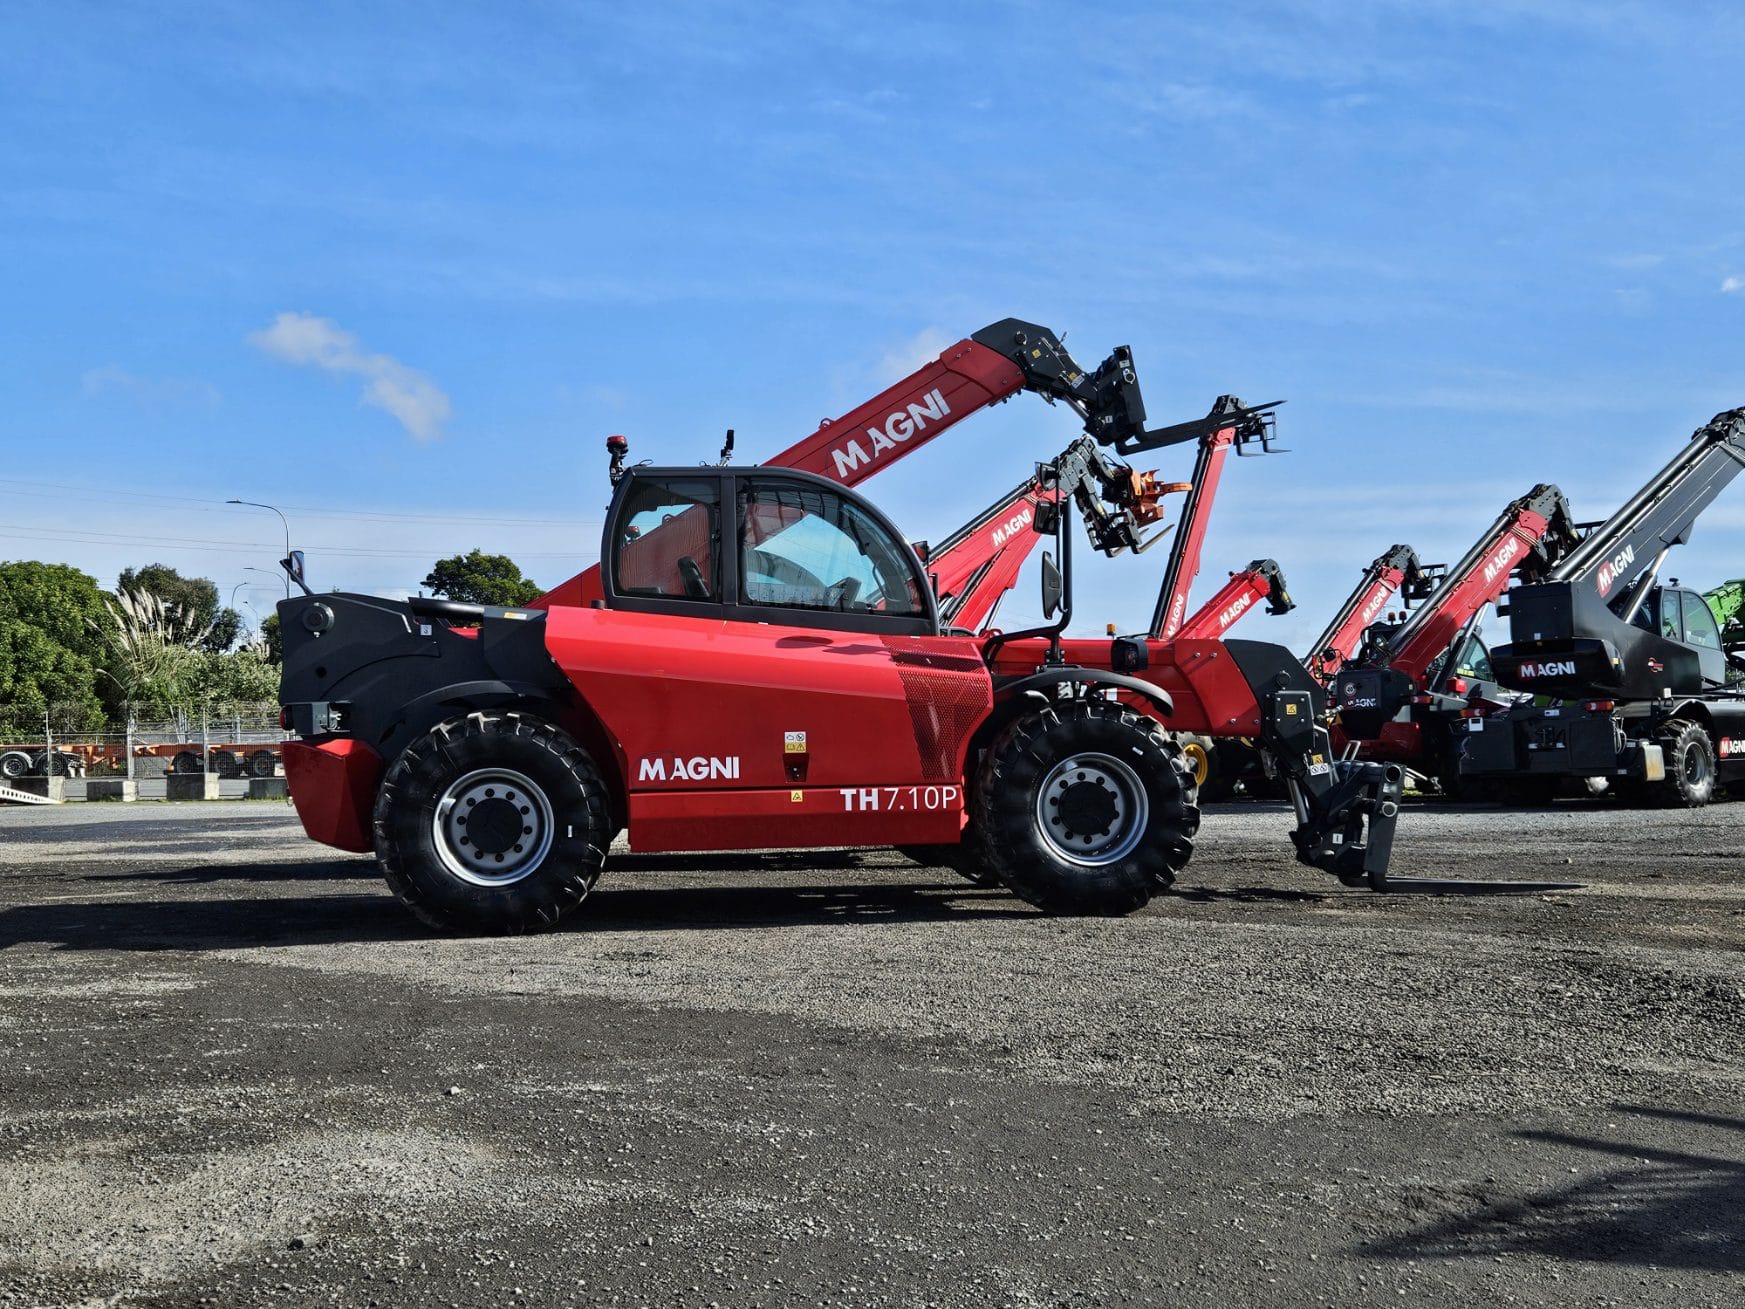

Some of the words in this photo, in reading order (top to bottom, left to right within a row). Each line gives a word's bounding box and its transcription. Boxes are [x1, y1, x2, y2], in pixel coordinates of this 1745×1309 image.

[831, 388, 952, 479] MAGNI
[992, 509, 1032, 547] MAGNI
[1483, 538, 1519, 583] MAGNI
[1597, 544, 1635, 590] MAGNI
[1167, 593, 1184, 637] MAGNI
[1219, 592, 1251, 628] MAGNI
[1362, 586, 1388, 623] MAGNI
[1520, 661, 1576, 678] MAGNI
[638, 756, 740, 781] MAGNI
[839, 788, 879, 811] TH
[884, 787, 957, 810] 7.10P
